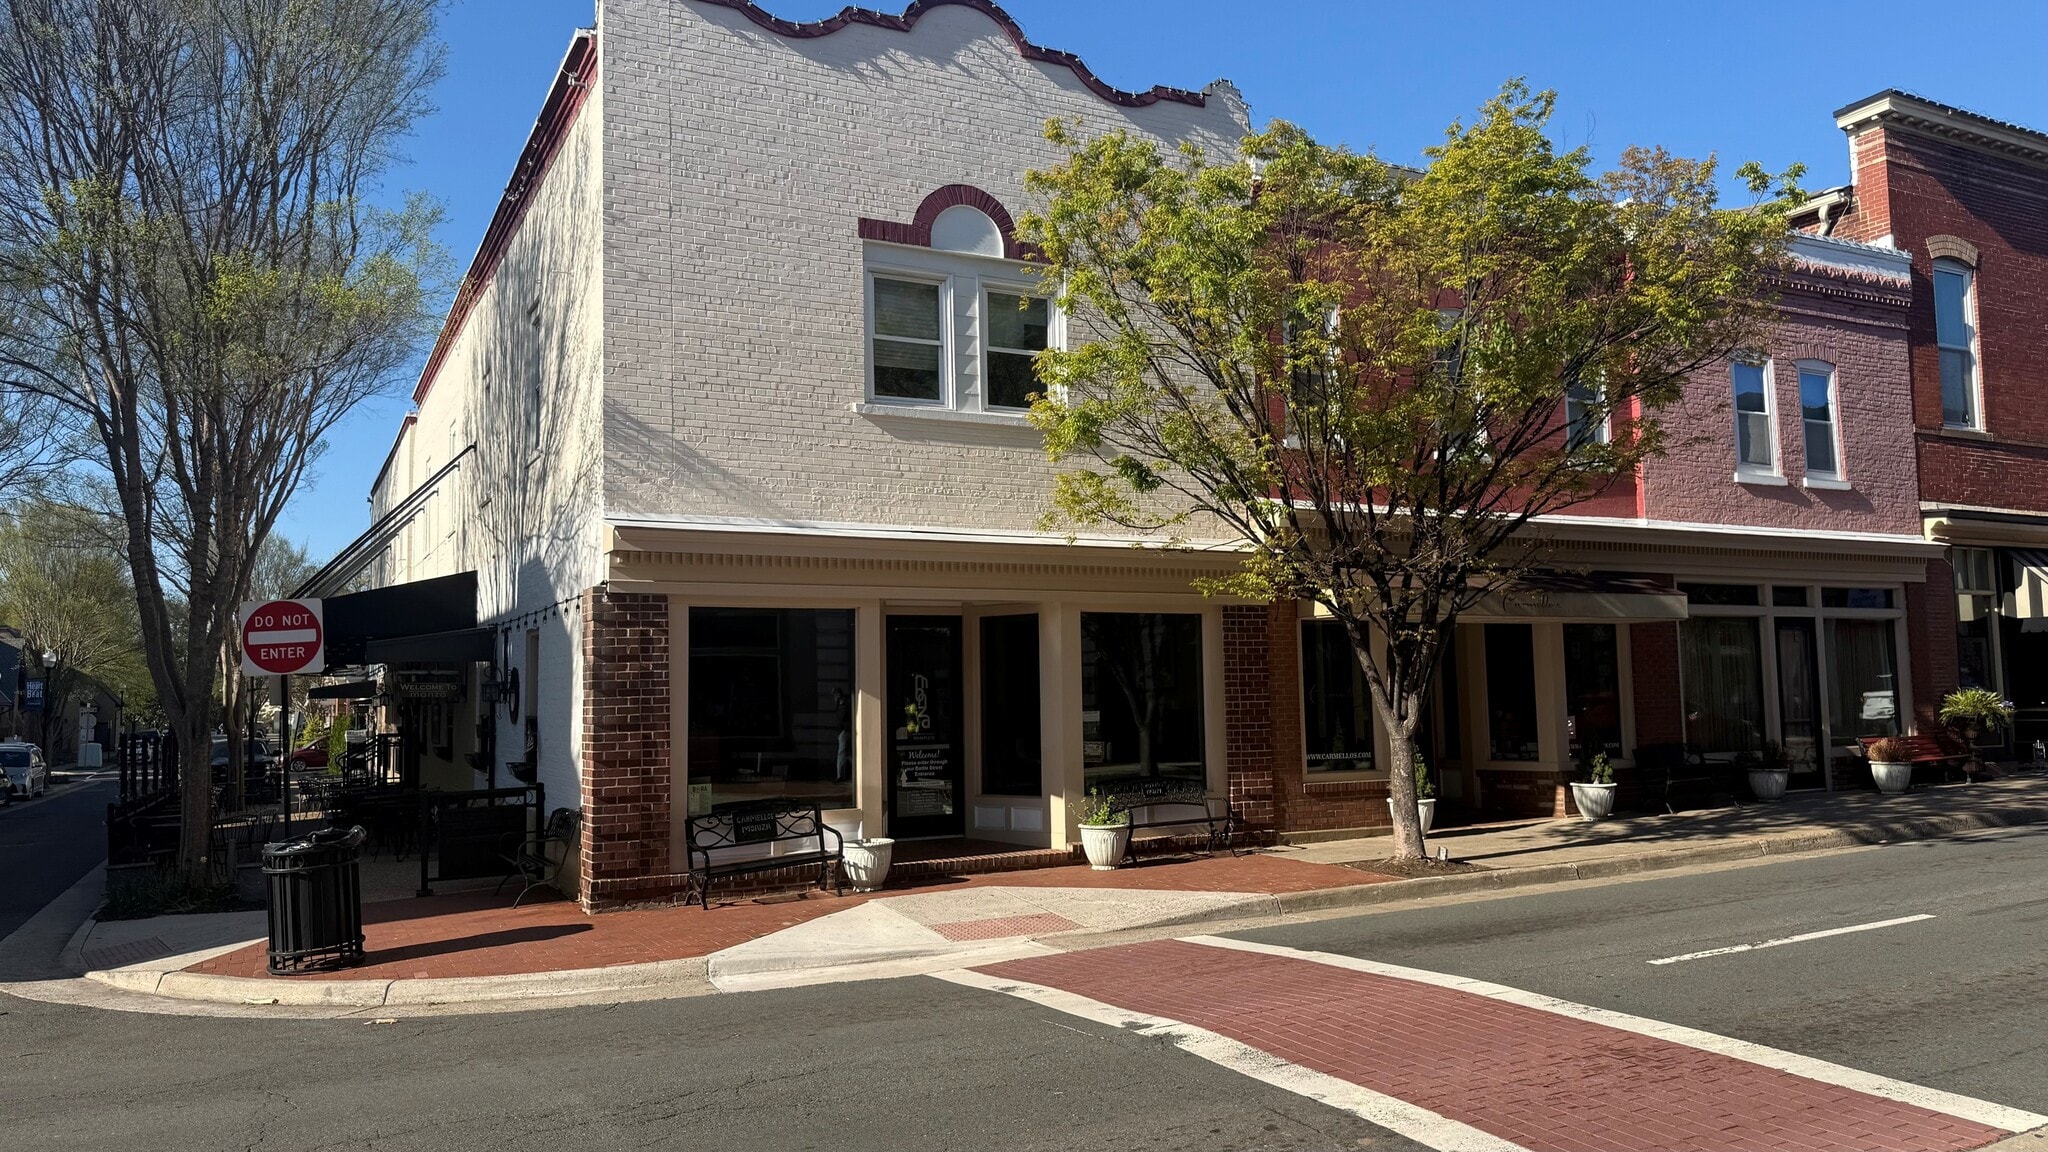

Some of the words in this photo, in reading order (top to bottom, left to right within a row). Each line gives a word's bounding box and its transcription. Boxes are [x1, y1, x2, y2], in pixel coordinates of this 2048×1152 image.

[254, 615, 274, 628] DO
[282, 613, 310, 626] NOT
[260, 646, 305, 660] ENTER
[26, 681, 43, 690] Heart
[400, 683, 444, 691] WELCOME
[26, 690, 43, 698] Beat
[908, 749, 940, 759] Welcome!
[741, 823, 772, 834] MONZA
